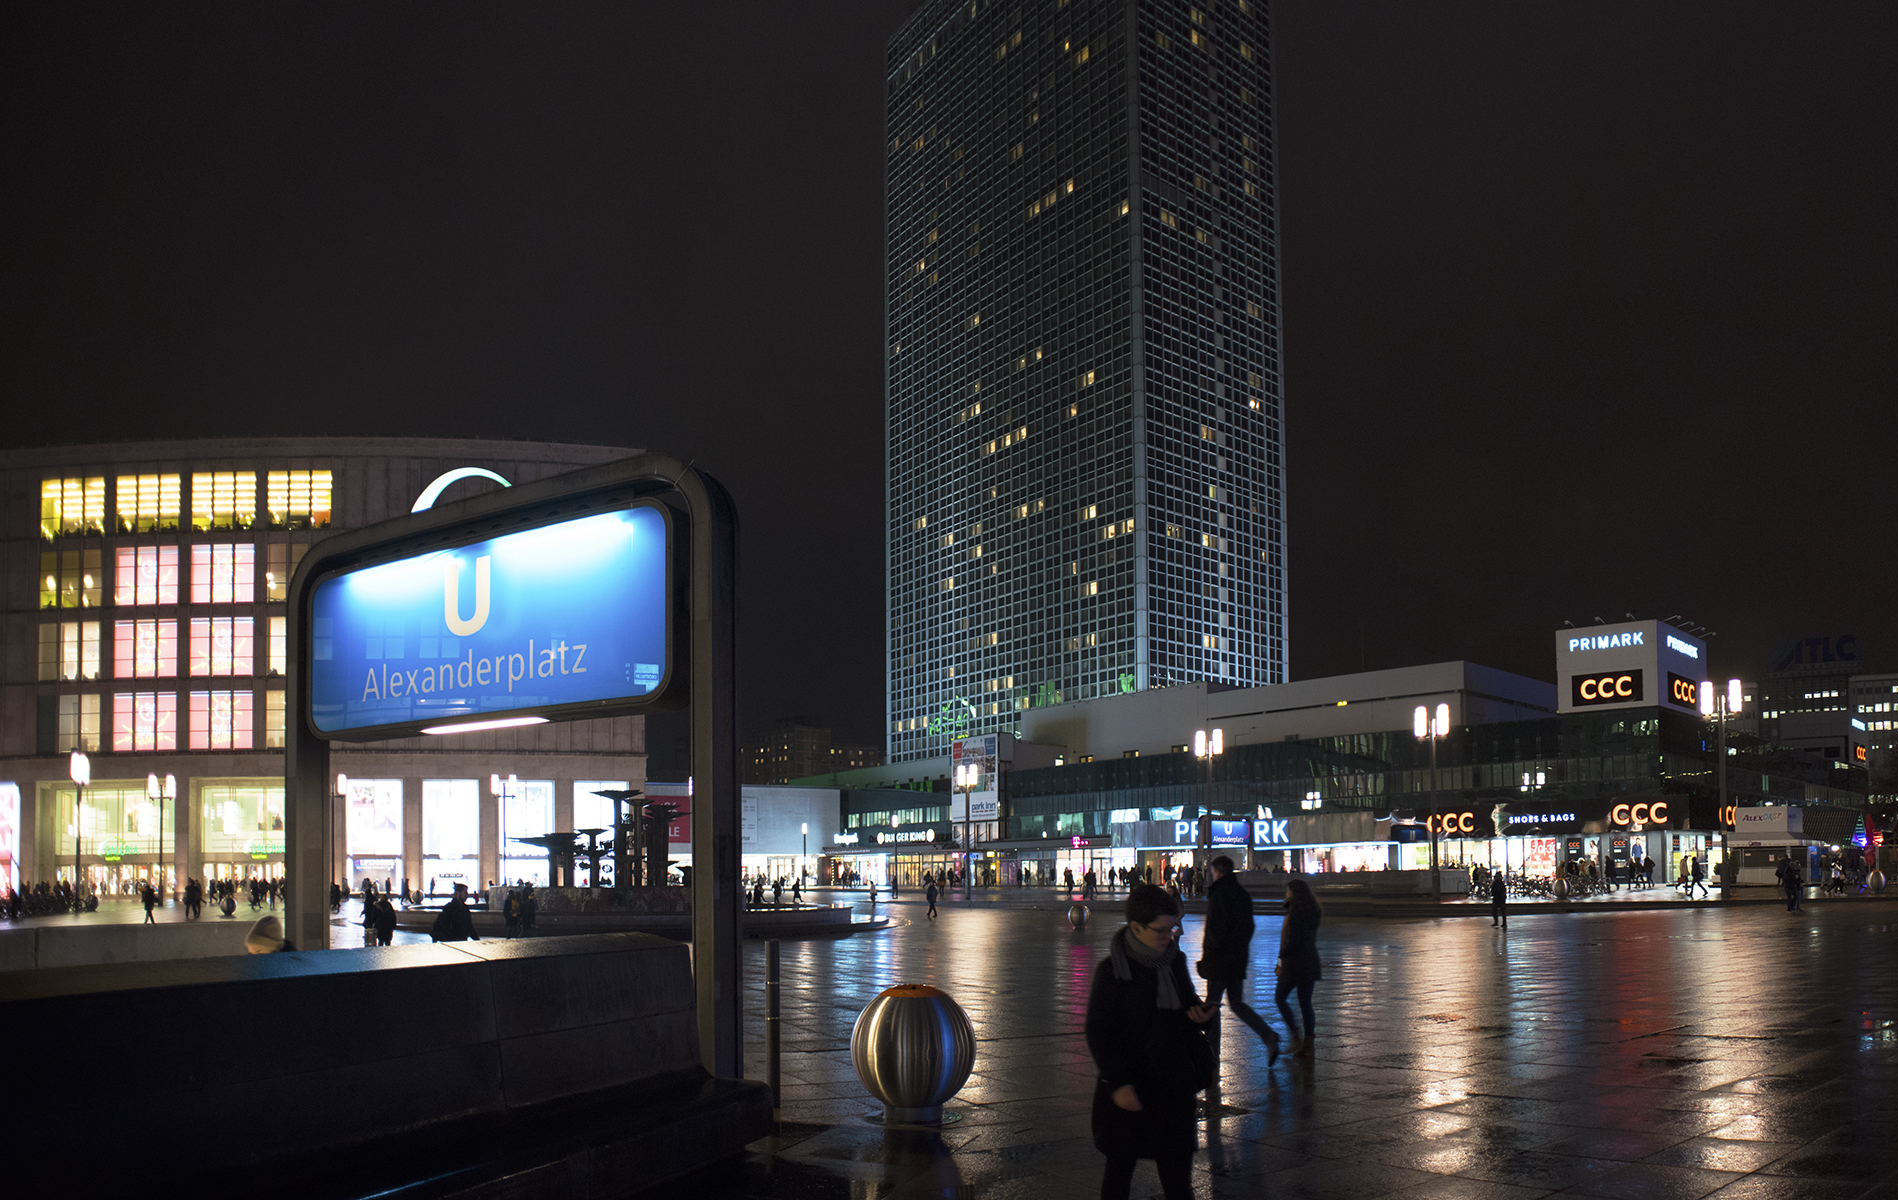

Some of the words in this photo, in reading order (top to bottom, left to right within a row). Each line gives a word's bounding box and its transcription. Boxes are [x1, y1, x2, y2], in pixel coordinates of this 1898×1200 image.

[444, 554, 491, 636] U
[1569, 631, 1644, 652] PRIMARK
[1666, 635, 1699, 659] PRIMARK
[362, 638, 588, 702] Alexanderplatz
[1580, 676, 1632, 700] CCC
[1673, 679, 1696, 704] CCC
[972, 801, 985, 813] park
[986, 801, 996, 810] inn
[1612, 802, 1668, 825] CCC
[1224, 821, 1233, 836] U
[1508, 815, 1539, 825] SHOES
[1541, 813, 1549, 823] &
[1550, 813, 1575, 822] BAGS
[104, 844, 139, 856] GALERIA
[250, 843, 285, 854] GALERIA
[1213, 835, 1244, 844] Alexanderplatz
